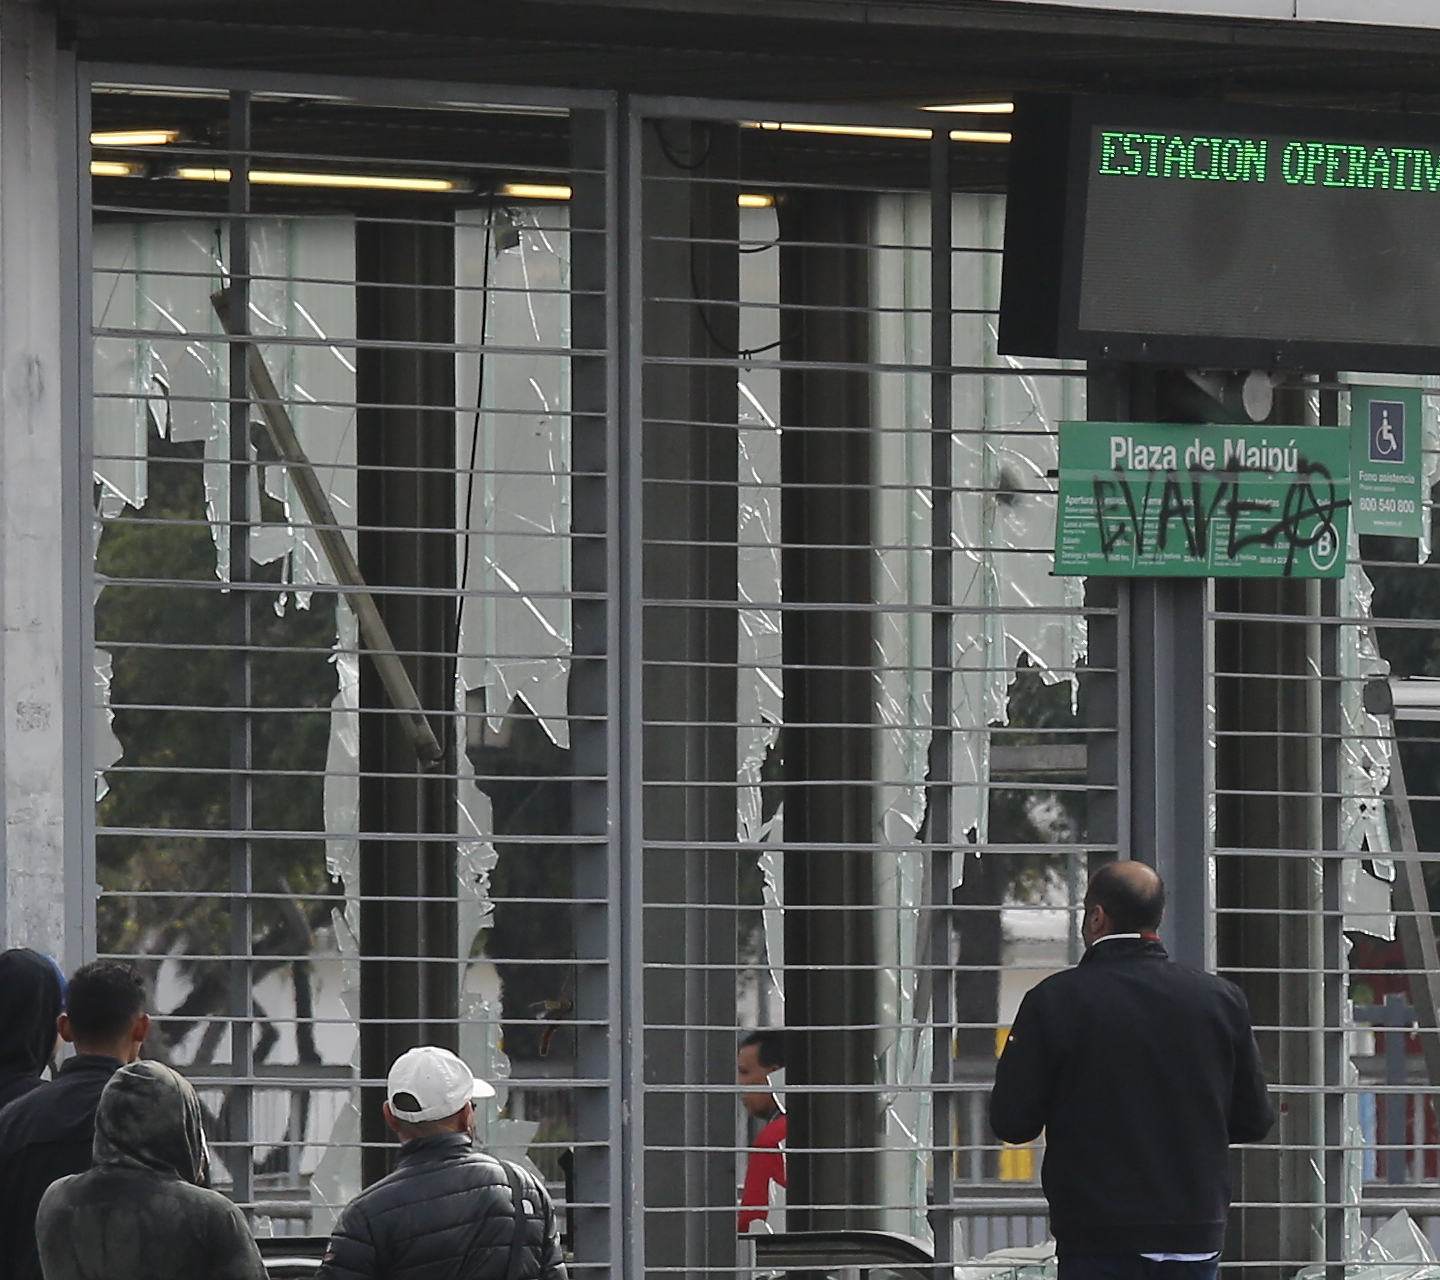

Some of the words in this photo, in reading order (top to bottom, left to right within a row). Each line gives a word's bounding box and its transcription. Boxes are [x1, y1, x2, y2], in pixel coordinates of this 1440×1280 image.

[1098, 131, 1268, 182] ESTACION
[1110, 436, 1177, 471] Plaza
[1184, 438, 1216, 470] de
[1223, 438, 1299, 478] Maipú
